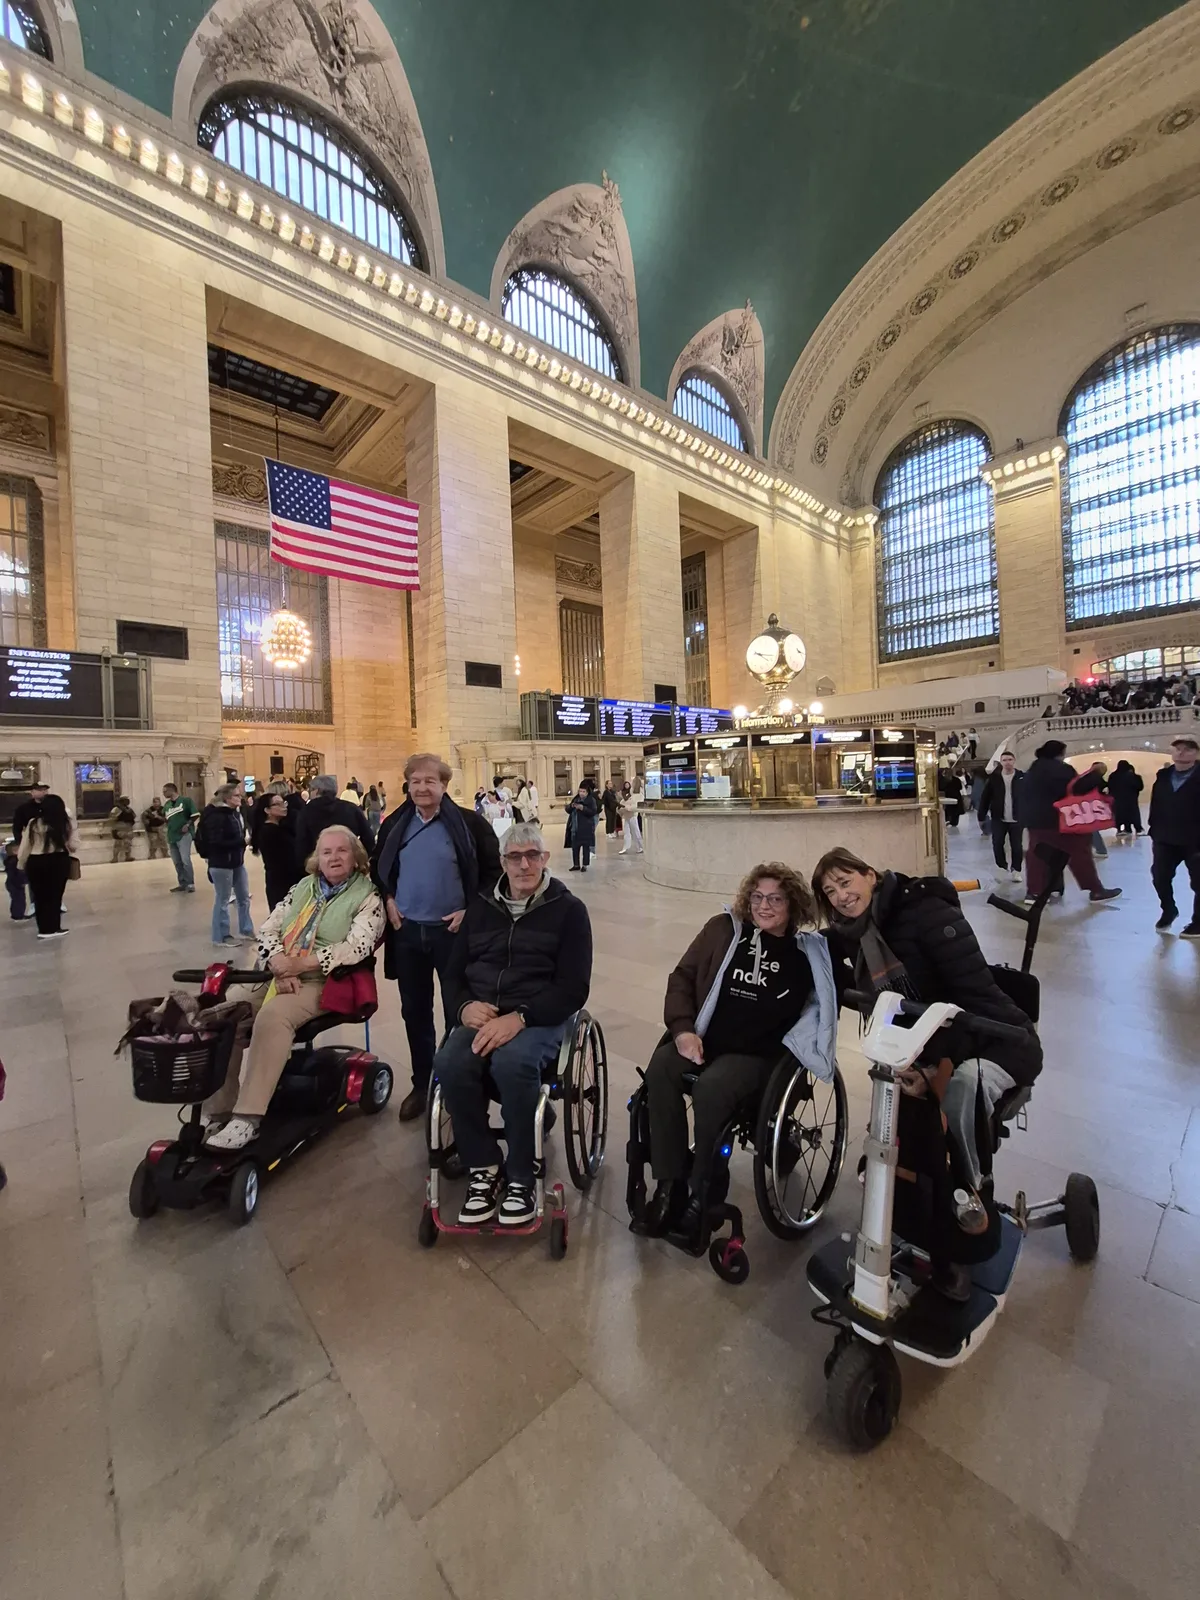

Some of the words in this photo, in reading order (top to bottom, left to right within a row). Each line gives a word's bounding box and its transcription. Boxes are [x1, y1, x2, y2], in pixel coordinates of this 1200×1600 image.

[8, 649, 70, 660] INFORMATION
[741, 715, 784, 728] Information
[760, 960, 781, 973] ze
